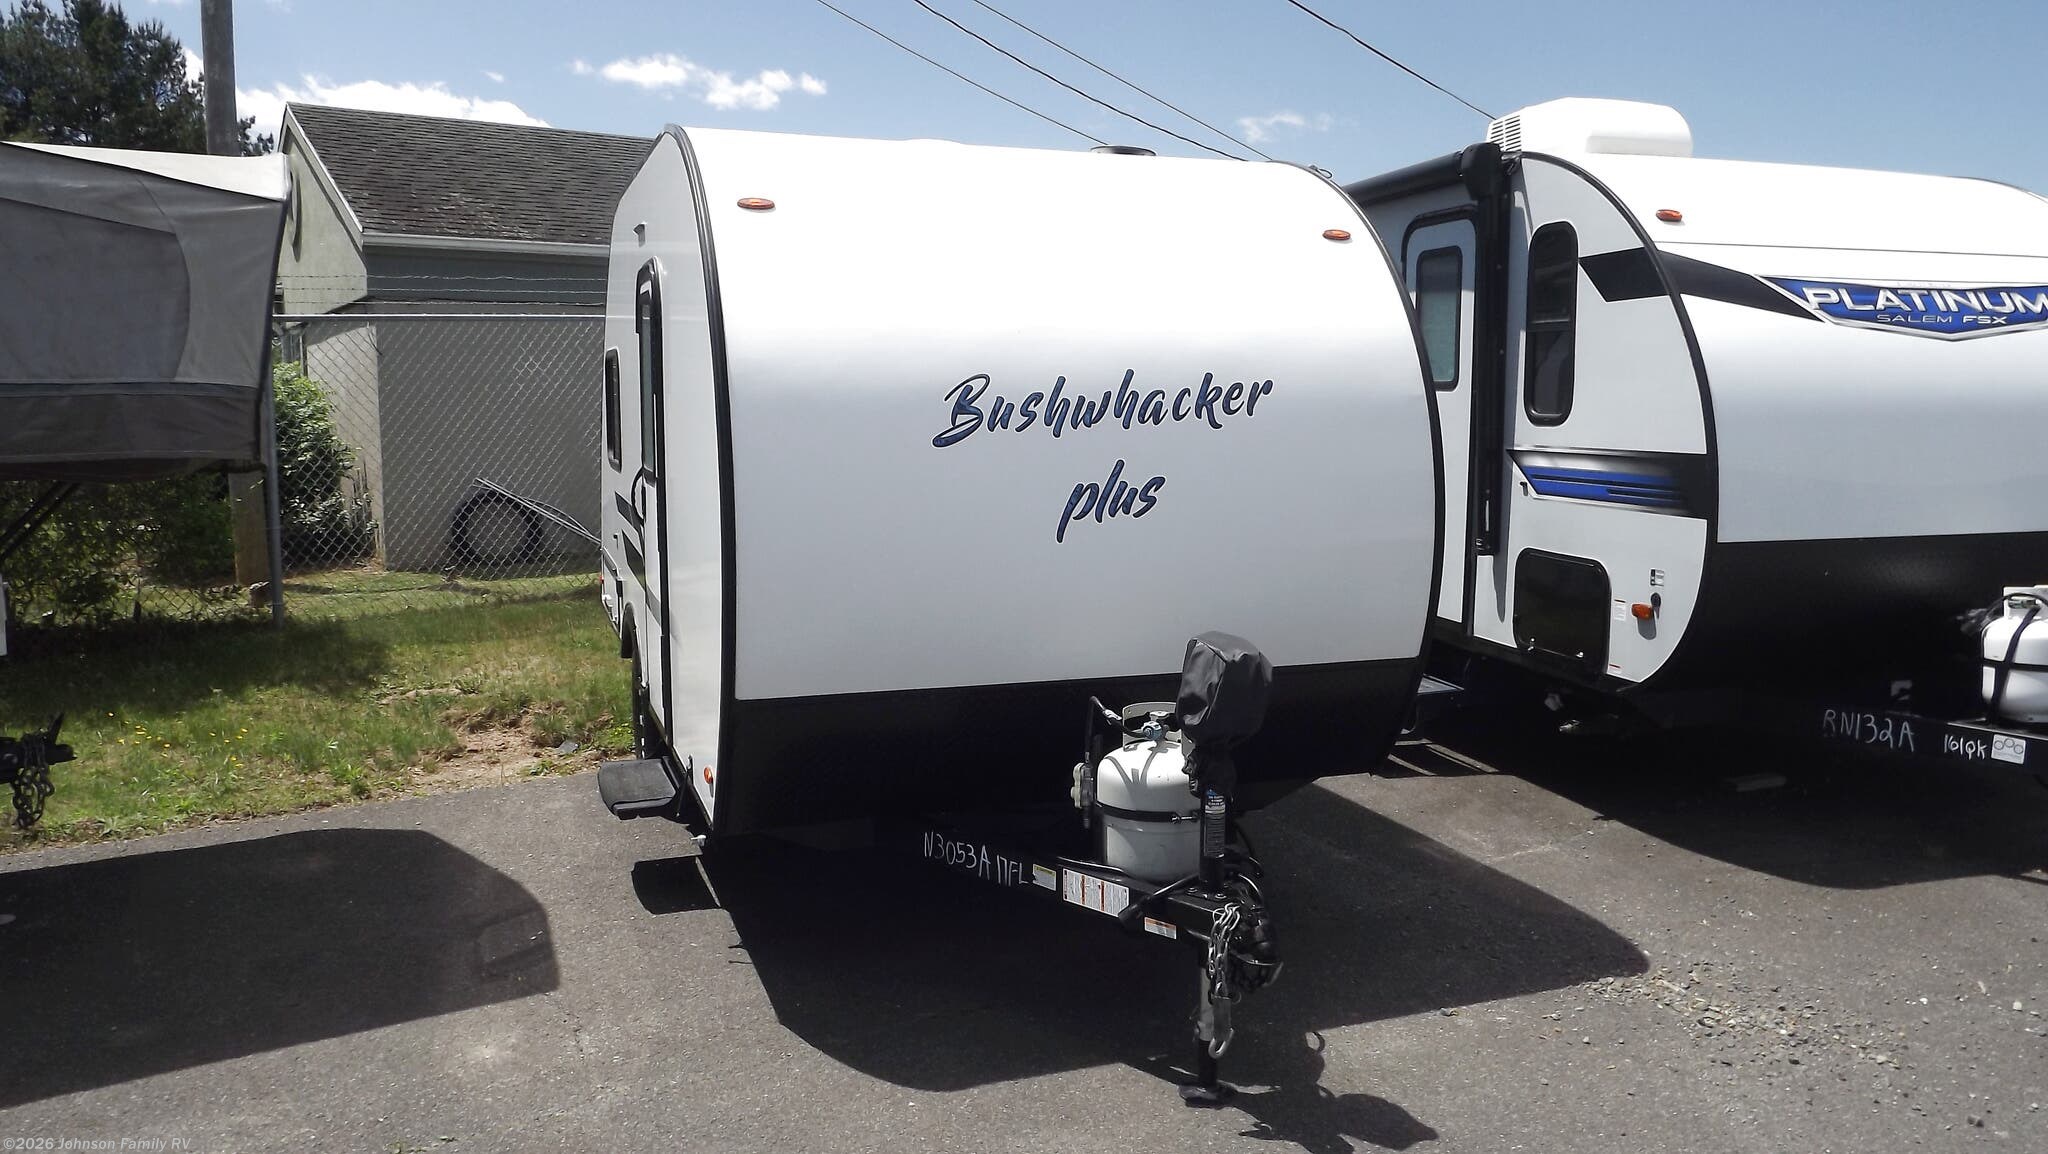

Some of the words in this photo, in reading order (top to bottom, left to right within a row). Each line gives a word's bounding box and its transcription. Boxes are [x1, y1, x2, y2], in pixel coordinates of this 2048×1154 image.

[1802, 287, 2048, 314] PLATINUM
[1876, 314, 1952, 323] SALEM
[1962, 315, 2007, 324] FSX
[932, 368, 1274, 448] Bushwhacker
[1055, 459, 1166, 543] plus
[924, 831, 991, 880] N3053A
